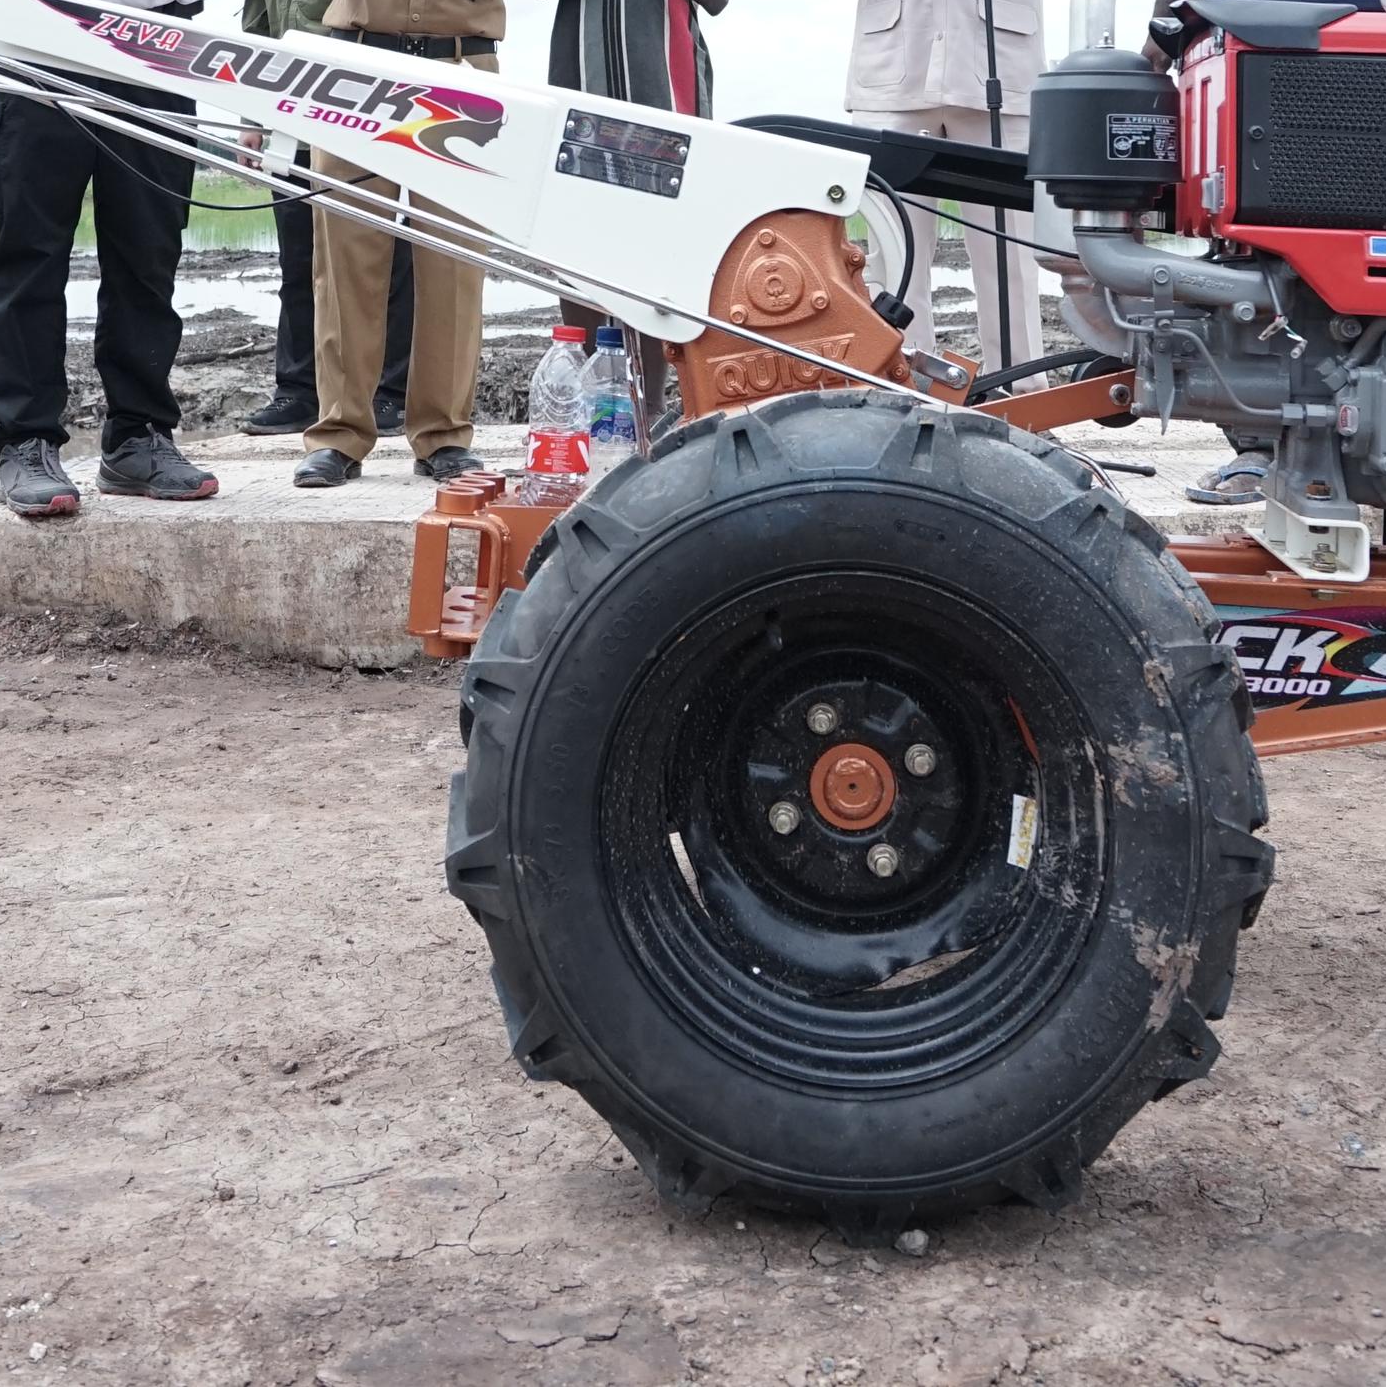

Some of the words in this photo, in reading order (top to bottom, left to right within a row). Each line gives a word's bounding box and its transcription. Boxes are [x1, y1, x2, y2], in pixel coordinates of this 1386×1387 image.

[90, 13, 185, 51] ZEVA
[189, 39, 432, 121] QUICK
[277, 99, 299, 115] G
[303, 105, 381, 134] 3000
